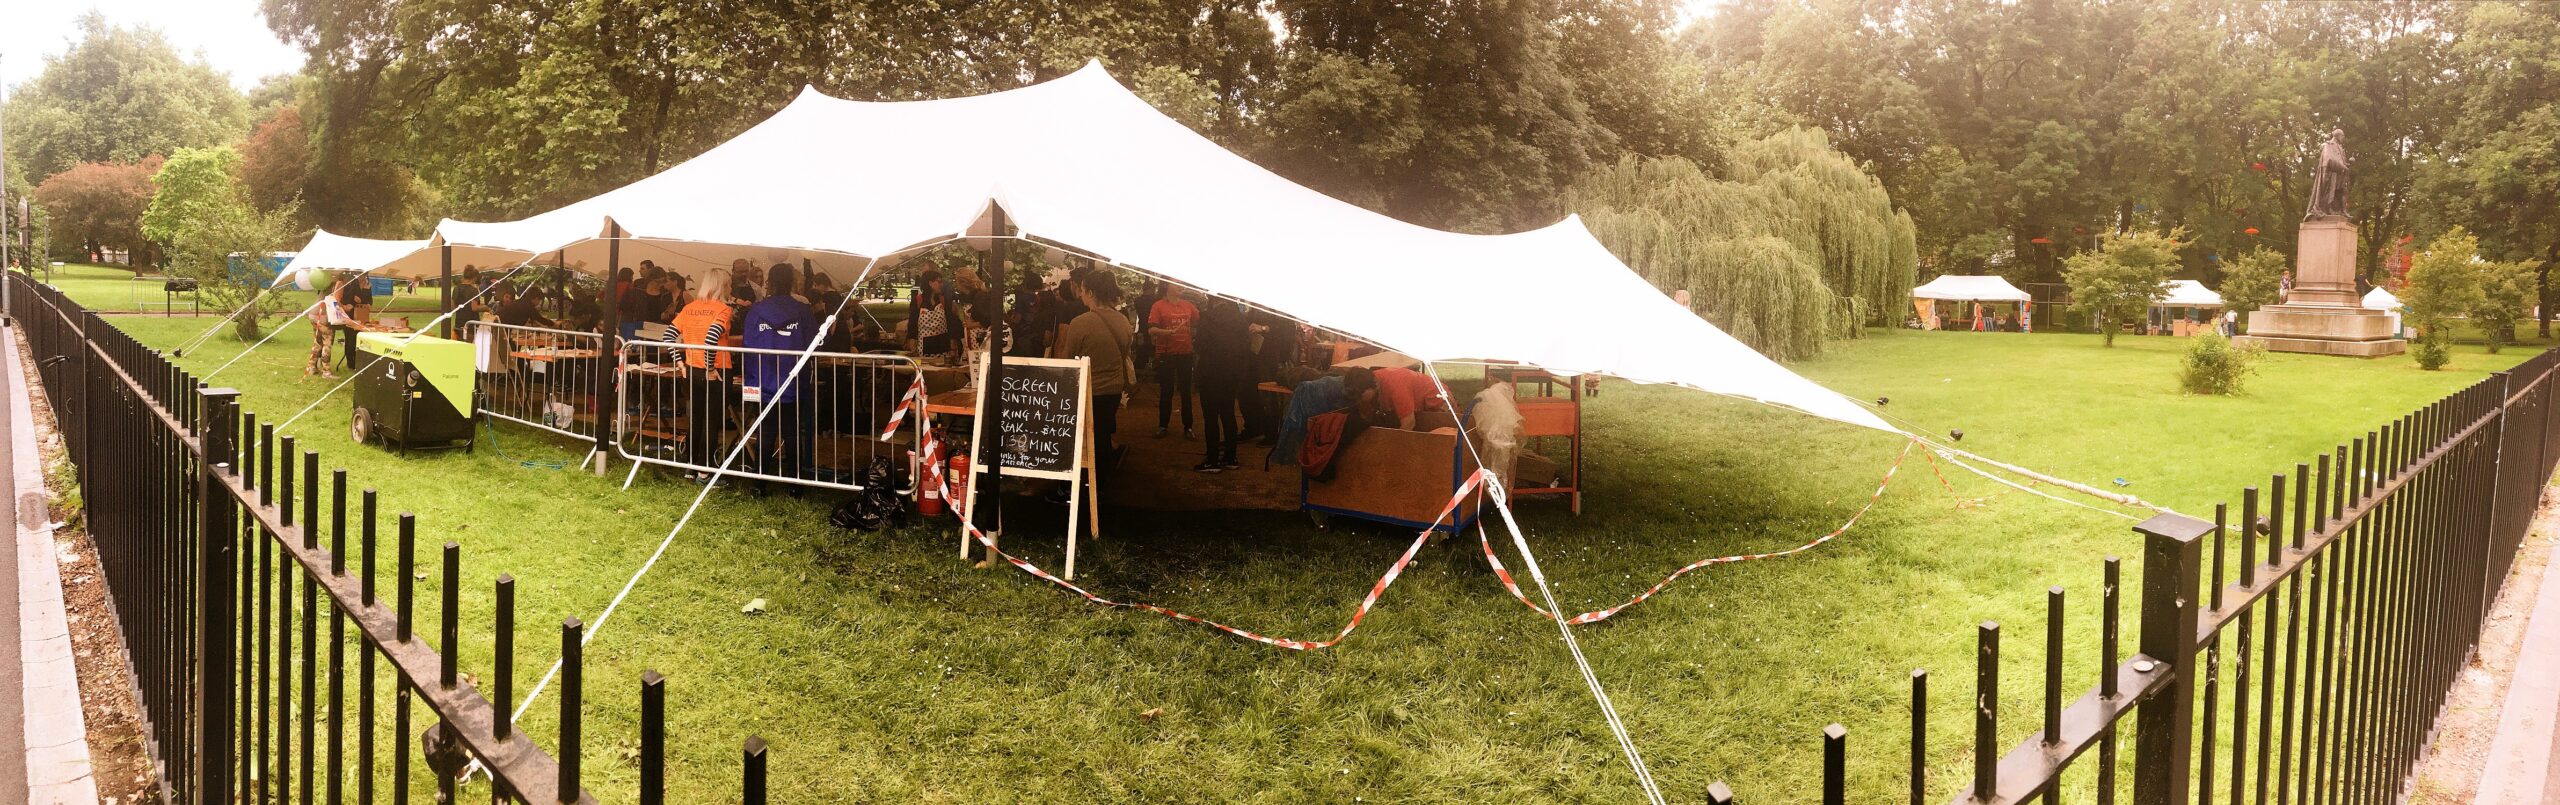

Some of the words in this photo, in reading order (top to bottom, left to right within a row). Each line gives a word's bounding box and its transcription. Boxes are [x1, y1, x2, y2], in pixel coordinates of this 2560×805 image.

[1001, 376, 1058, 395] SCREEN
[1001, 391, 1051, 410] RINTING
[1060, 398, 1071, 410] IS
[1001, 408, 1030, 421] KING
[1034, 410, 1041, 420] A
[1045, 412, 1077, 425] LITTLE
[1041, 424, 1071, 437] BACK
[1029, 439, 1060, 455] MINS
[1019, 452, 1031, 463] for
[1035, 456, 1059, 466] your
